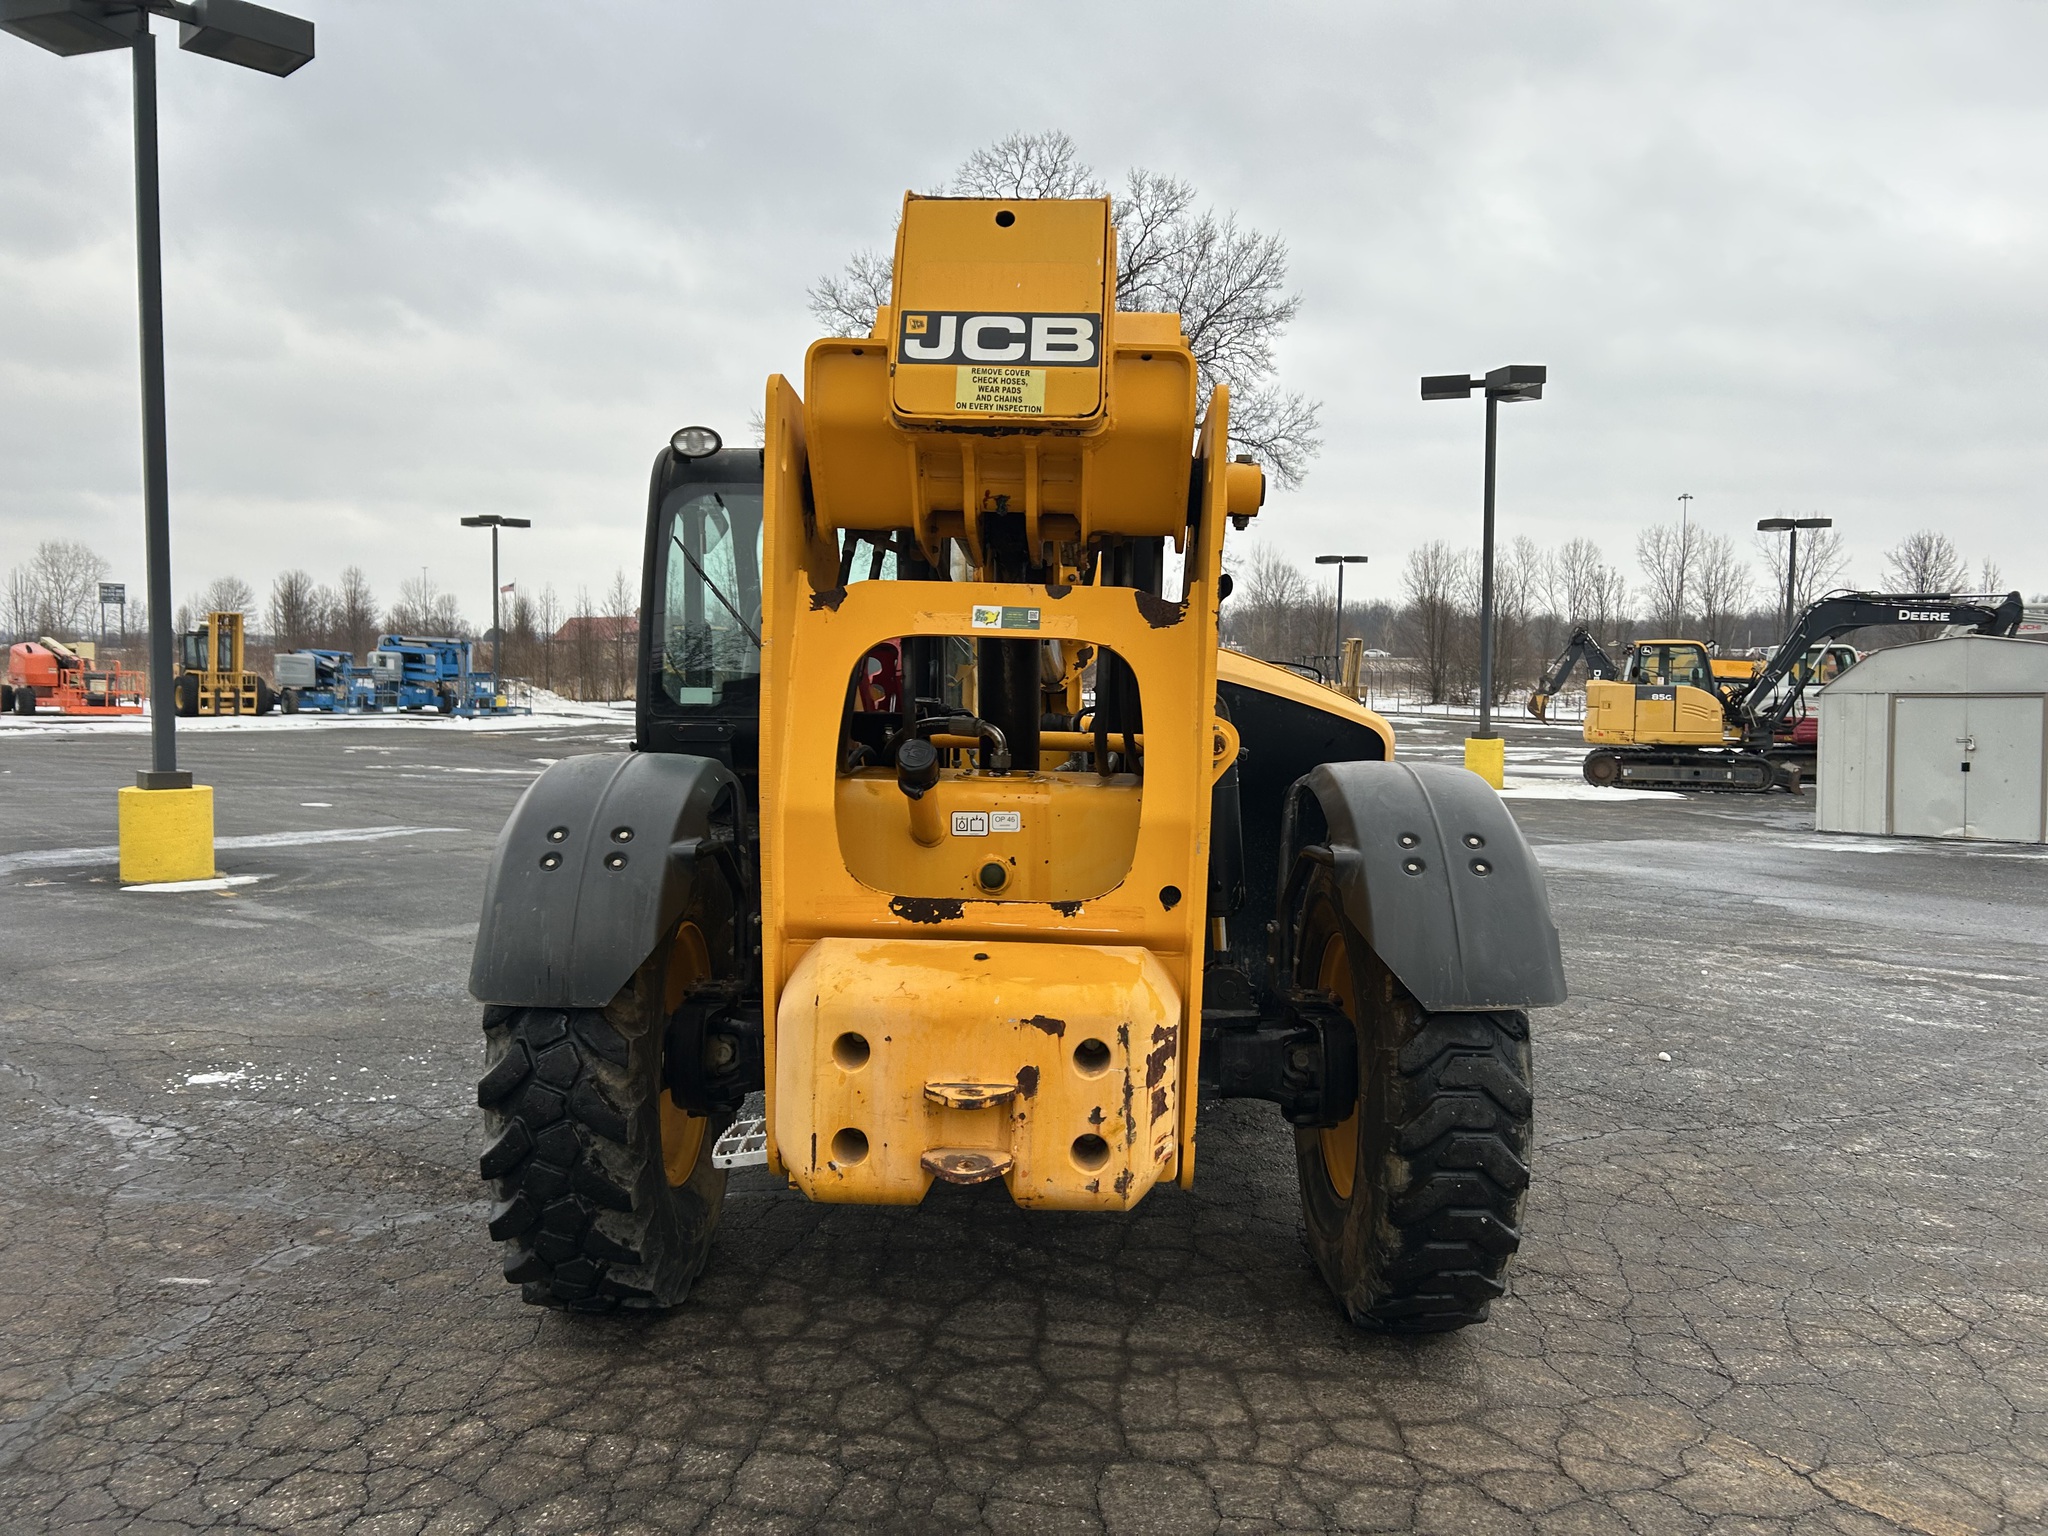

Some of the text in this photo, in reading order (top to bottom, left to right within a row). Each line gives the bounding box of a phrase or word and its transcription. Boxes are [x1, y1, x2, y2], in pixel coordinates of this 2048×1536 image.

[904, 315, 1095, 362] JCB
[971, 367, 1031, 377] REMOVE COVER
[972, 376, 1029, 387] CHECK HOSES,
[978, 385, 1022, 394] WEAR PADS
[976, 394, 1023, 403] AND CHAINS
[969, 402, 994, 411] EVERY
[995, 403, 1042, 413] INSPECTION
[1898, 609, 1951, 622] DEERE
[1651, 693, 1672, 701] 85G
